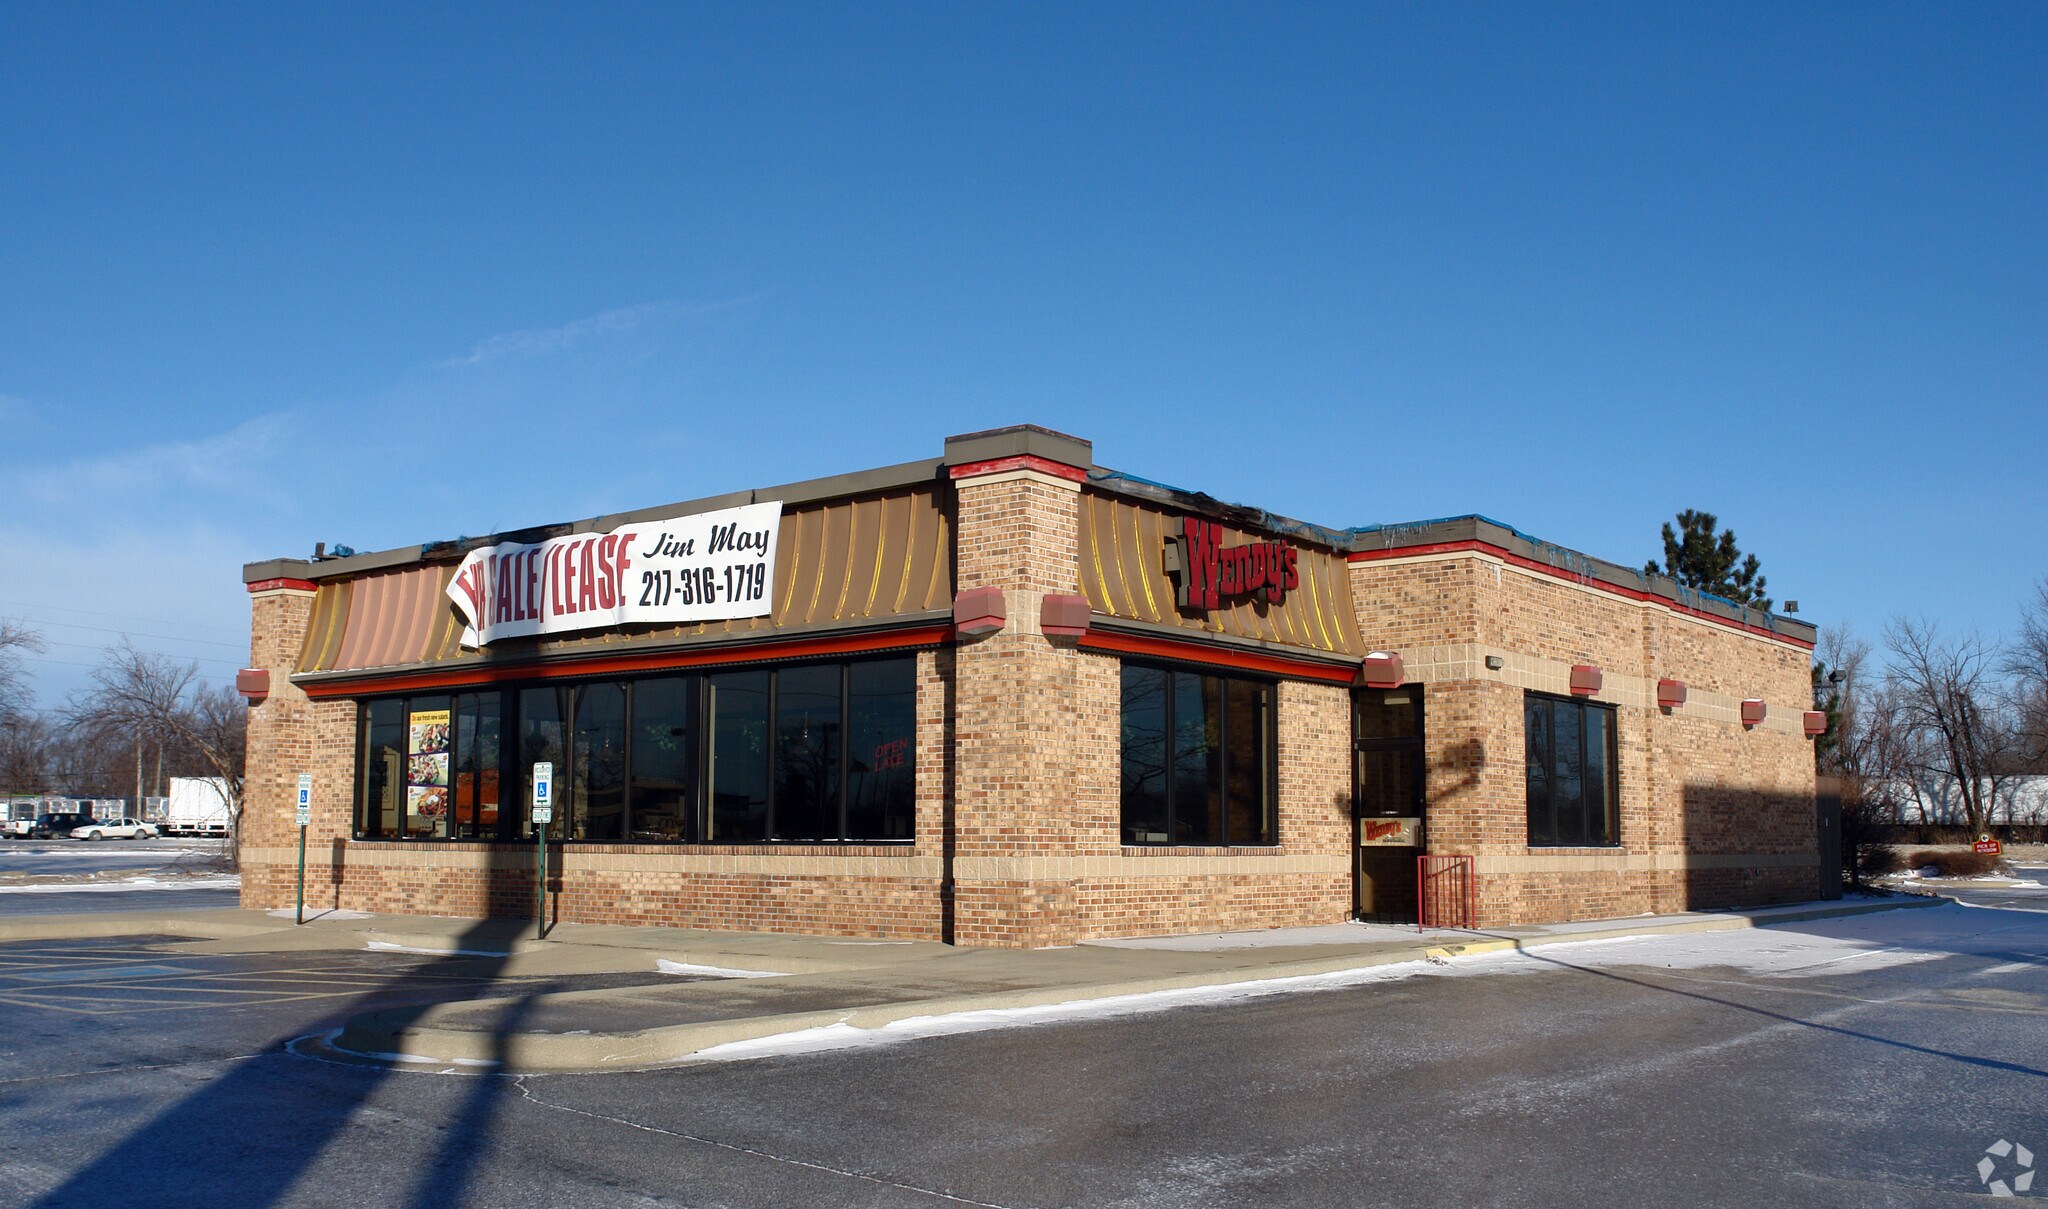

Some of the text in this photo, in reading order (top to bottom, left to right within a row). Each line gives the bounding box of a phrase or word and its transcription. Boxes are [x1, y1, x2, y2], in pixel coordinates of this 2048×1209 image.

[643, 522, 769, 558] Jim May
[489, 533, 637, 627] SALE/LEASE
[639, 563, 766, 606] 217-316-1719
[875, 738, 908, 758] OPEN
